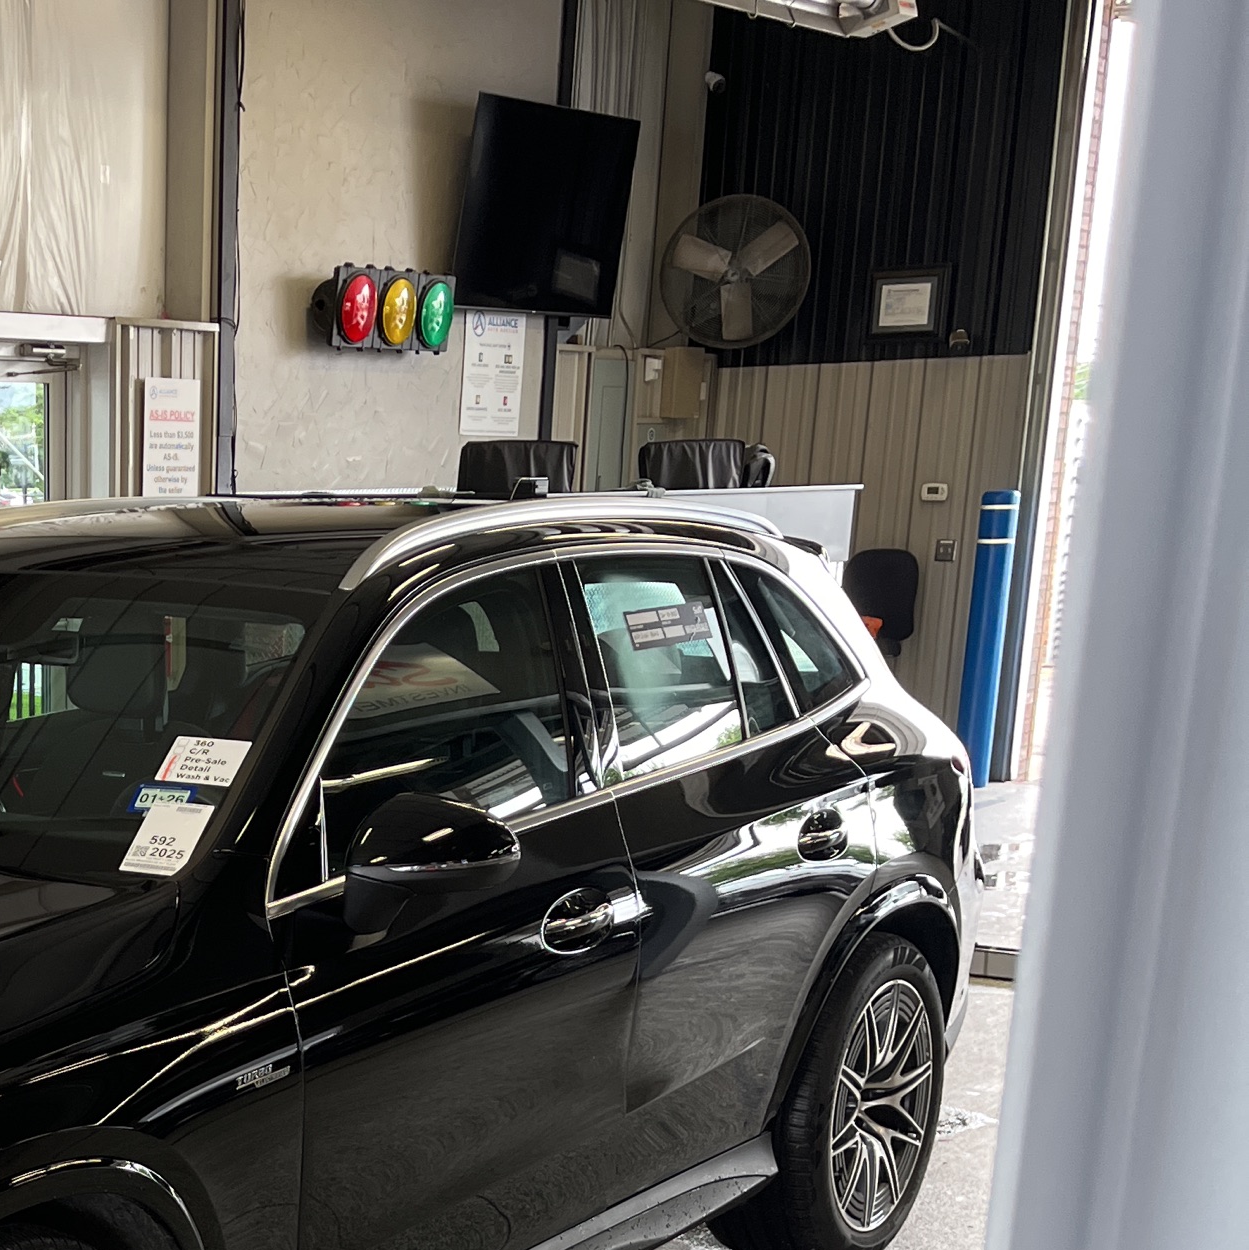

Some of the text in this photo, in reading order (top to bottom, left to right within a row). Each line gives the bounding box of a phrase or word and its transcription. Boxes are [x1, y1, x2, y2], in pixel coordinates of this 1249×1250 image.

[488, 316, 519, 329] ALLIANCE
[149, 409, 195, 421] AS-IS POLICY
[150, 430, 163, 439] Less
[164, 431, 176, 439] than
[159, 443, 194, 451] automatically
[147, 464, 195, 473] Unless guaranteed
[154, 475, 187, 484] otherwise by
[193, 739, 214, 748] 360
[189, 748, 210, 756] C/R
[184, 756, 227, 766] Pre-Sale
[180, 763, 211, 773] Detail
[176, 772, 201, 781] Wash
[213, 776, 230, 784] Vac
[149, 835, 176, 847] 592
[149, 847, 186, 860] 2025
[236, 1064, 273, 1086] TURBO
